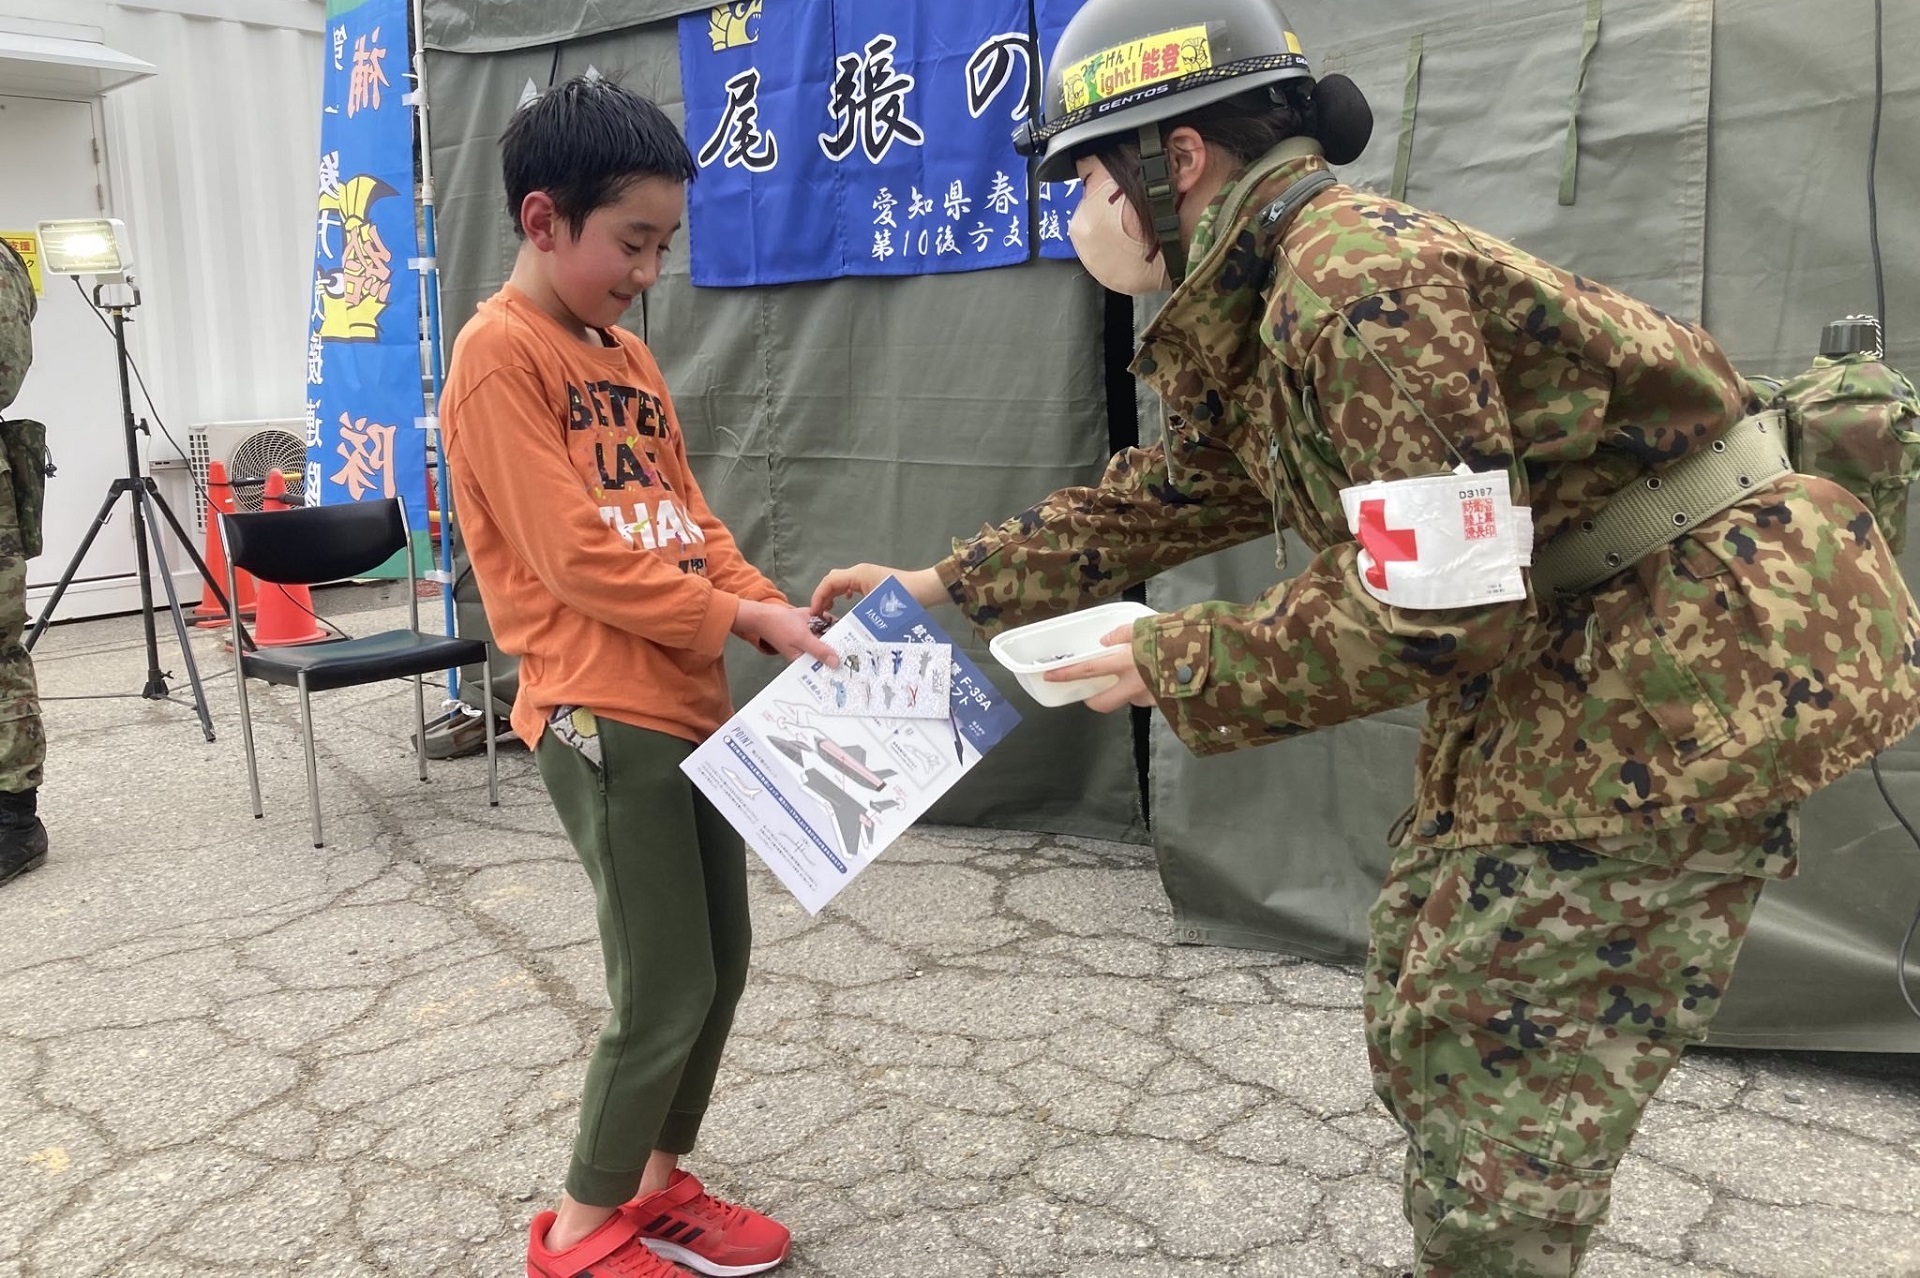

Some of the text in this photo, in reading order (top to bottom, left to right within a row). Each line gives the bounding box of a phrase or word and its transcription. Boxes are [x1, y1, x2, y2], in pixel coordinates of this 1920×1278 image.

[1140, 43, 1182, 83] 能登
[698, 33, 1041, 172] 尾張の
[1099, 84, 1169, 113] GENTOS
[864, 608, 888, 631] JASDF
[959, 675, 993, 712] F-35A
[731, 724, 755, 750] POINT
